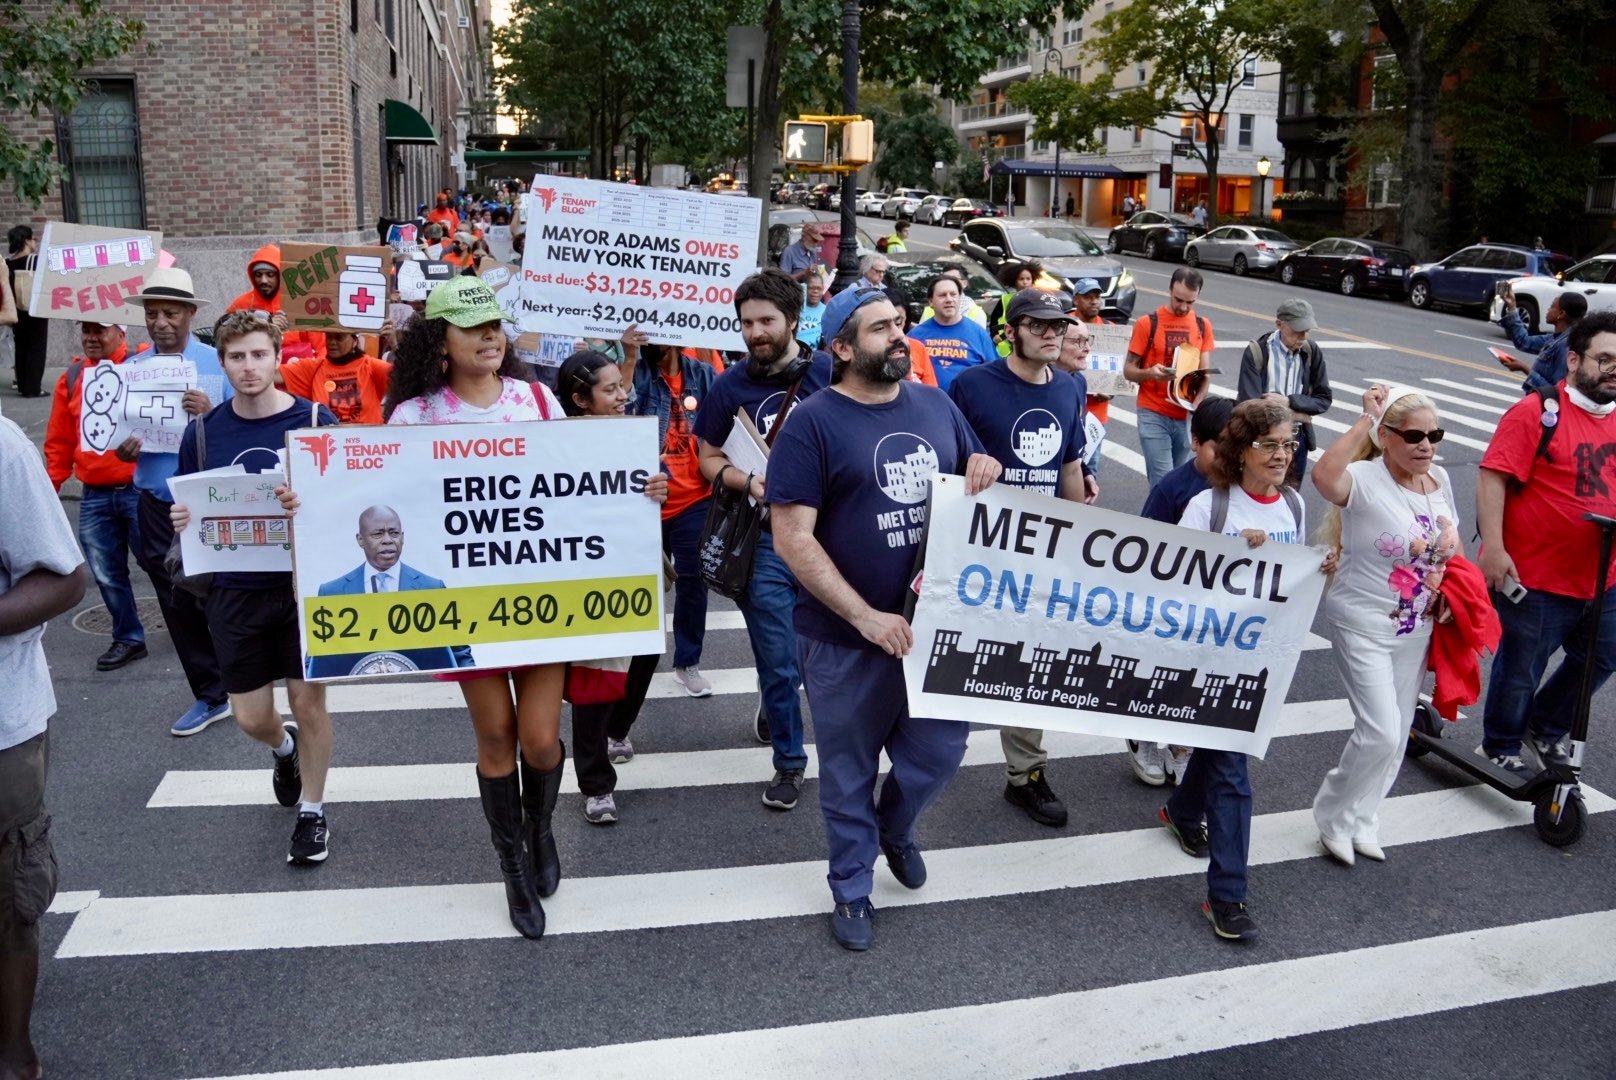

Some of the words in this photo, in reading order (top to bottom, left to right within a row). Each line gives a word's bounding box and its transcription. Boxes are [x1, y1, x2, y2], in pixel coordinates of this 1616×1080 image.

[561, 197, 596, 208] TENANT
[561, 205, 585, 215] BLOC
[541, 224, 610, 246] MAYOR
[614, 233, 681, 253] ADAMS
[685, 239, 740, 259] OWES
[282, 245, 340, 300] RENT
[547, 245, 592, 263] NEW
[594, 250, 646, 269] YORK
[650, 255, 731, 278] TENANTS
[51, 275, 145, 314] RENT
[416, 281, 427, 289] OR
[524, 270, 553, 284] Past
[556, 272, 584, 287] due:
[585, 272, 736, 305] $3,125,952,00
[304, 297, 335, 316] OR
[522, 299, 553, 314] Next
[557, 304, 591, 317] year:
[592, 302, 742, 333] $2,004,480,000
[584, 325, 605, 333] INVOICE
[543, 341, 557, 360] MY
[557, 342, 577, 361] REN
[925, 339, 961, 347] TENANTS
[926, 346, 968, 359] ZOHRAN
[124, 366, 193, 383] MEDICINE
[156, 430, 183, 446] REN
[432, 437, 526, 460] INVOICE
[343, 443, 401, 457] TENANT
[346, 457, 384, 470] BLOC
[443, 474, 521, 503] ERIC
[529, 469, 649, 499] ADAMS
[1005, 468, 1027, 482] MET
[1028, 469, 1059, 483] COUNCI
[208, 486, 240, 503] Rent
[444, 506, 545, 536] OWES
[876, 509, 906, 531] MET
[908, 505, 926, 524] CO
[887, 530, 906, 548] ON
[908, 527, 923, 545] HO
[444, 535, 606, 569] TENANTS
[968, 502, 1074, 559] MET
[1082, 529, 1289, 604] COUNCIL
[312, 587, 653, 643] $2,004,480,000
[957, 564, 1033, 614] ON
[1044, 578, 1268, 651] HOUSING
[963, 679, 1024, 701] Housing
[1026, 684, 1049, 701] for
[1051, 689, 1100, 709] People
[1128, 699, 1154, 715] Not
[1156, 703, 1197, 720] Profit
